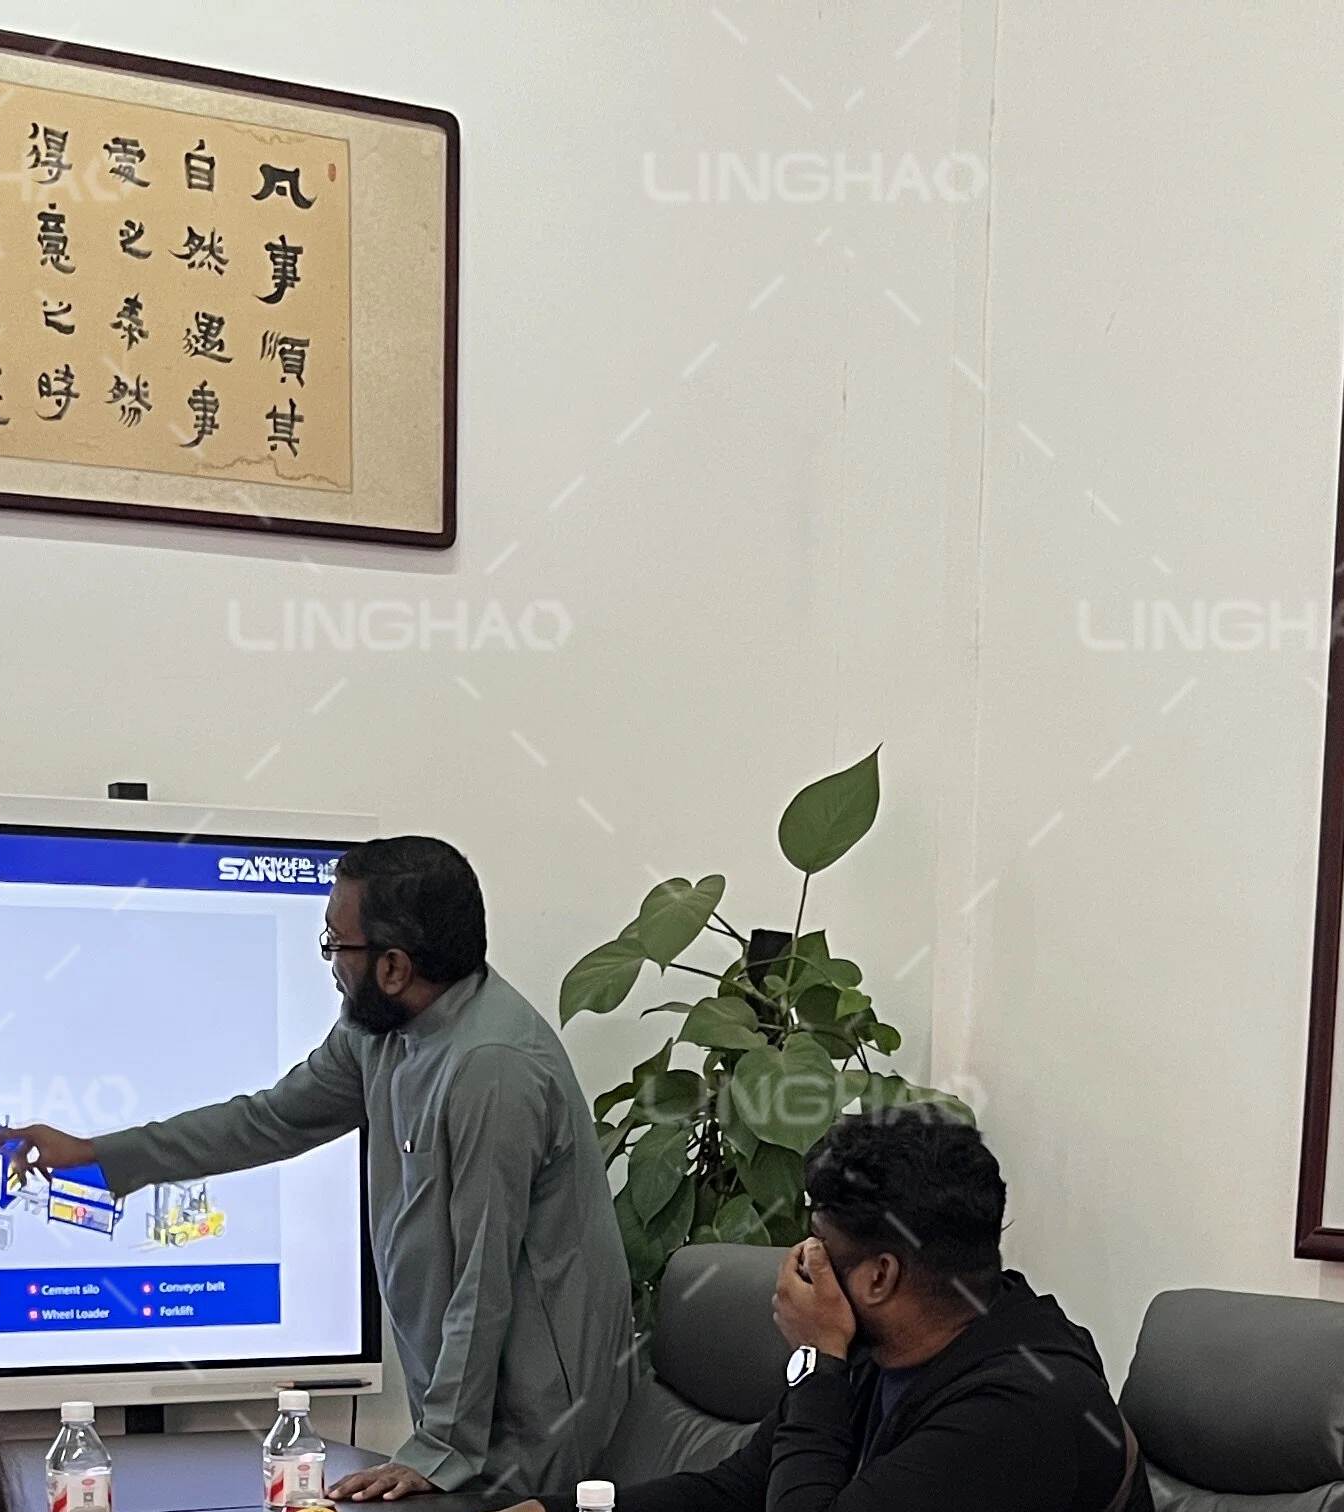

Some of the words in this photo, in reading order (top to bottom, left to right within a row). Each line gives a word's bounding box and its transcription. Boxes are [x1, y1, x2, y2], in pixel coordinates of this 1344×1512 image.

[41, 1284, 80, 1295] Cement
[82, 1283, 100, 1294] silo
[159, 1282, 204, 1294] Conveyor
[206, 1280, 225, 1292] belt
[42, 1307, 74, 1320] Wheel
[76, 1306, 110, 1320] Loader
[159, 1303, 195, 1318] Forklift
